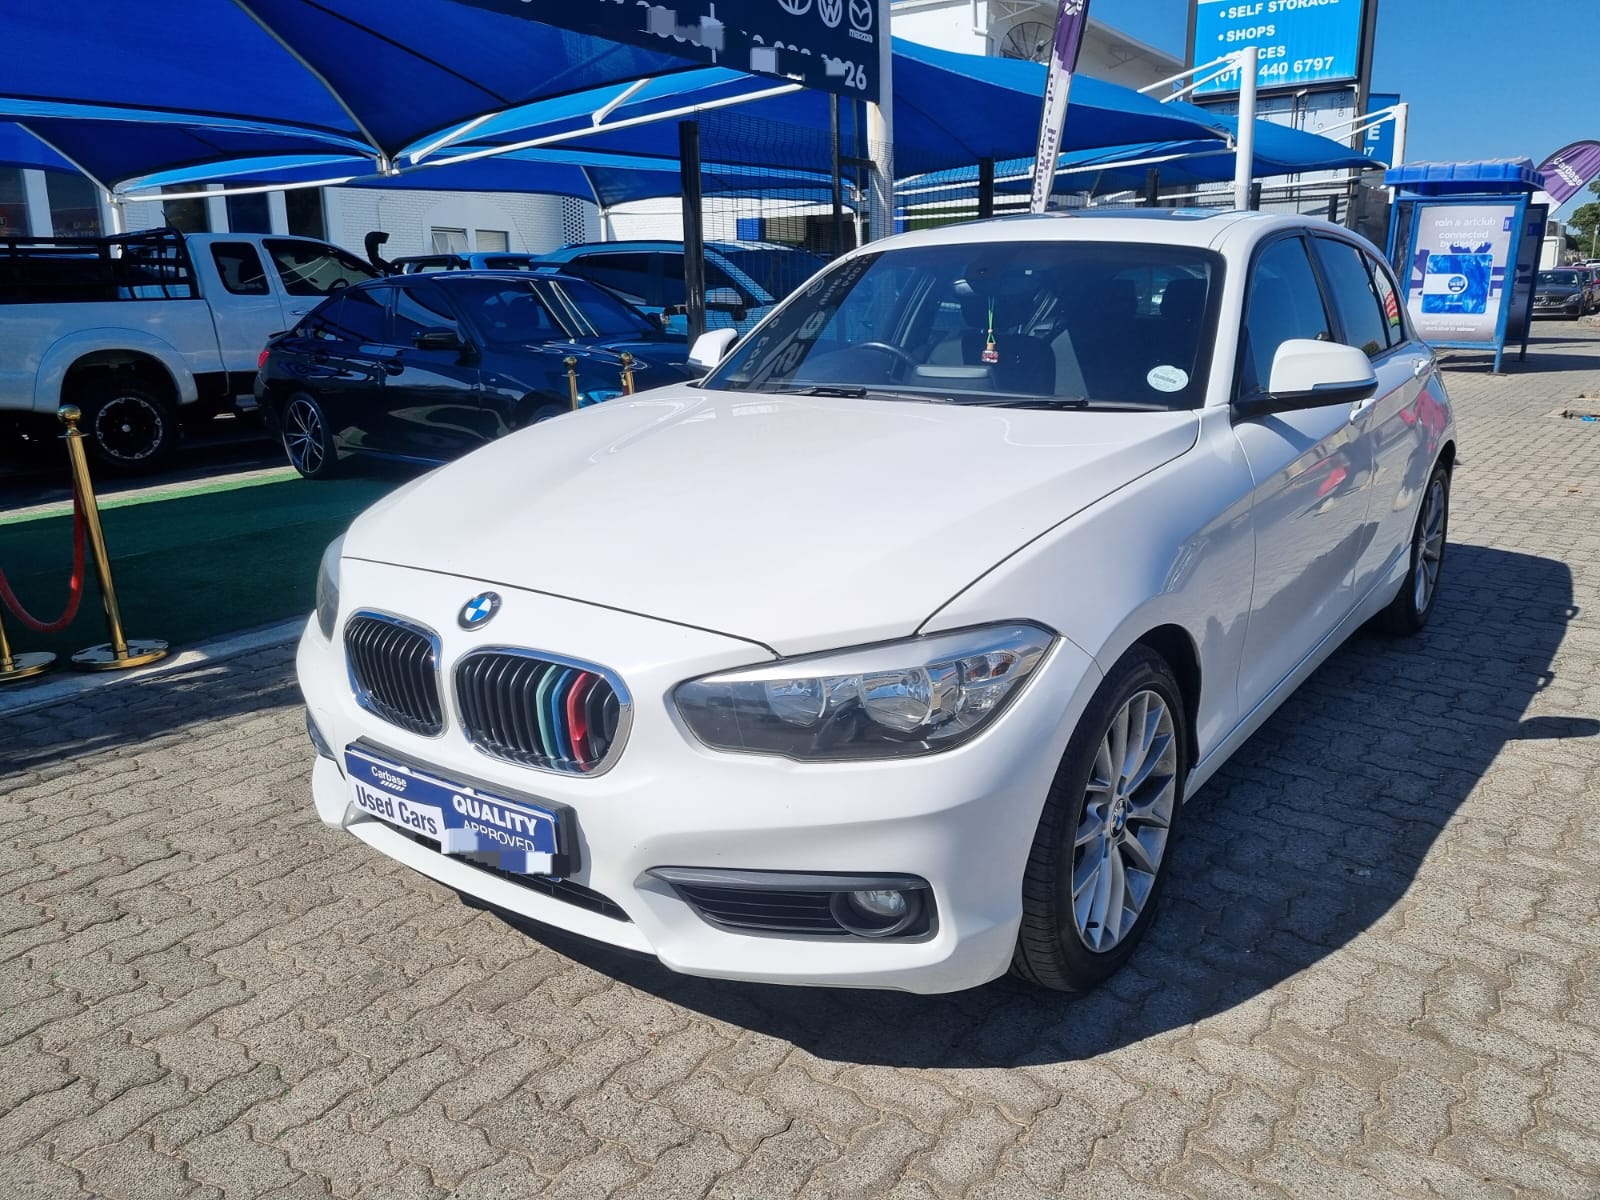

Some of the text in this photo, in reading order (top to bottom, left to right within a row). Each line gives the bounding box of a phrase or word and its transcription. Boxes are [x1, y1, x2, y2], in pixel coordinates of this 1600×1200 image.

[1228, 0, 1339, 18] SELF STORA
[1226, 25, 1275, 42] SHOPS
[1259, 62, 1288, 77] 440
[1293, 56, 1334, 73] 6797
[1439, 230, 1489, 239] connected
[1440, 239, 1485, 250] by design
[371, 766, 407, 787] Carbase
[355, 784, 438, 835] Used Cars
[452, 795, 538, 836] QUALITY
